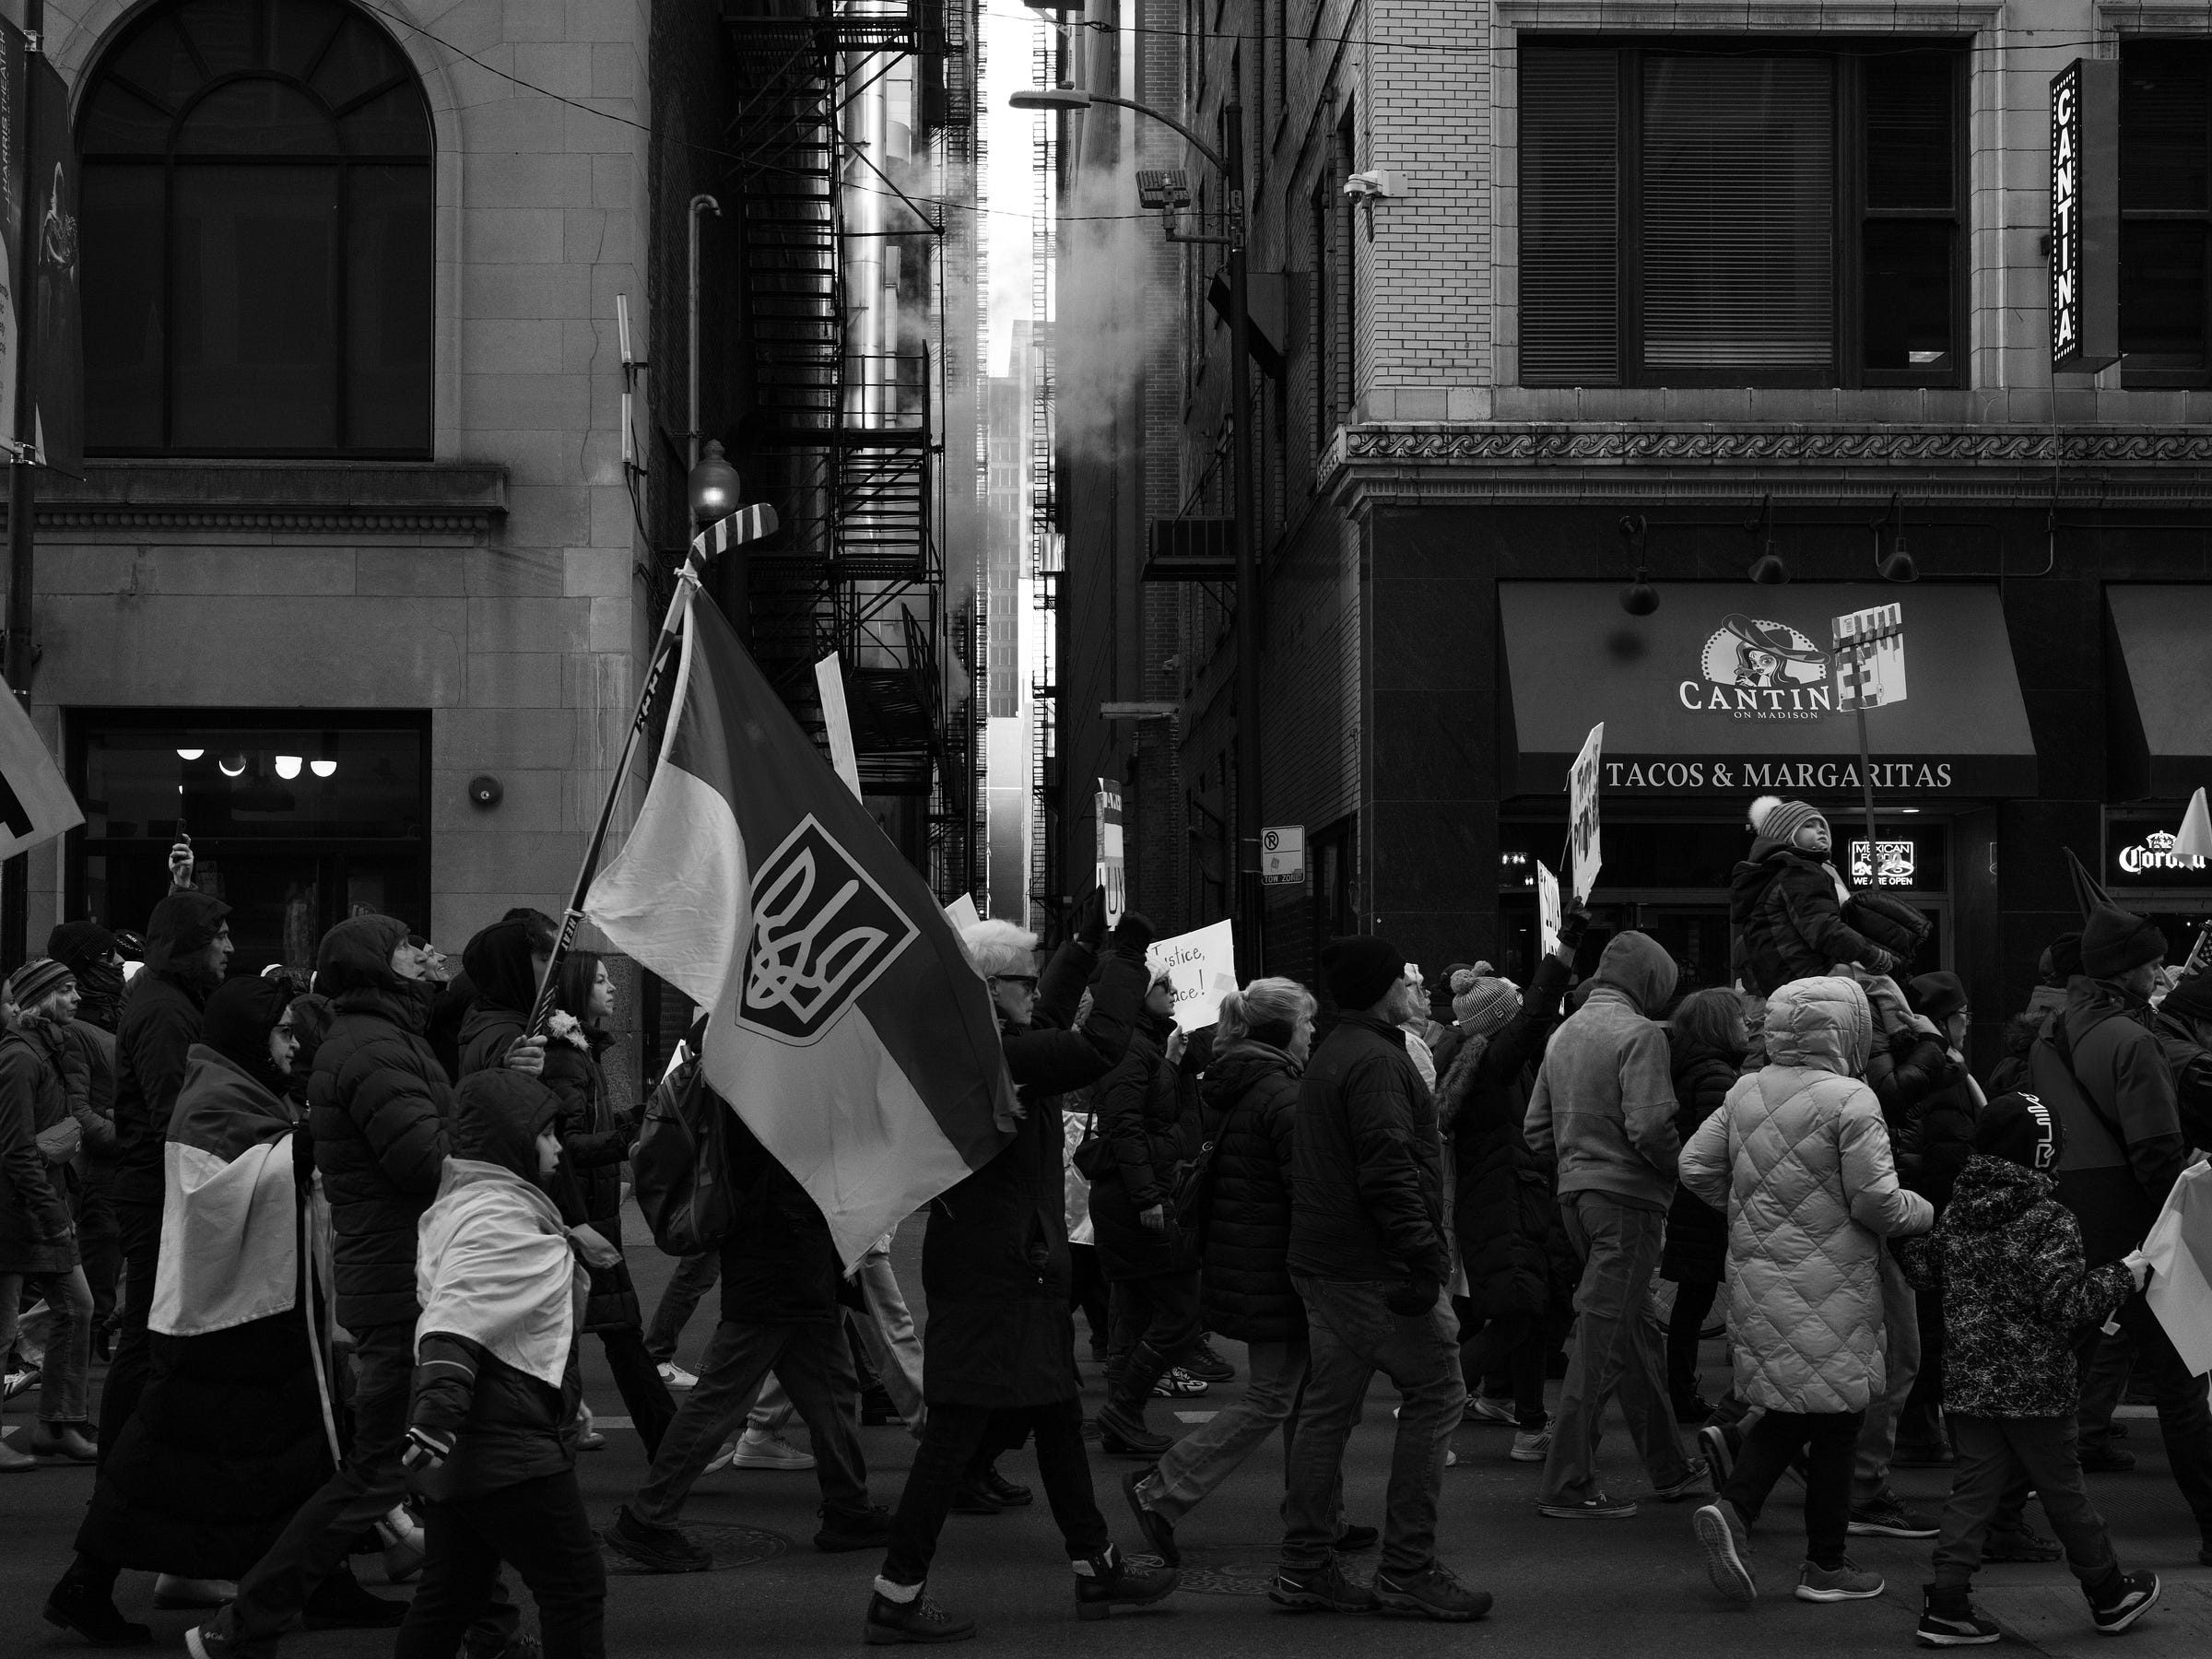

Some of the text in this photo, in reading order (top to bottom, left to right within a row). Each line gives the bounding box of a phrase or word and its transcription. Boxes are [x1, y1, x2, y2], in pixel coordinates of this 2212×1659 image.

[2057, 88, 2072, 347] CANTINA
[1679, 680, 1841, 711] CANTIN
[1734, 711, 1818, 719] ON MADISON
[1606, 762, 1704, 787] TACOS
[1712, 762, 1735, 787] &
[1742, 762, 1952, 787] MARGARITAS
[1855, 844, 1910, 853] MEXICAN
[2119, 844, 2206, 876] Coroa
[1853, 877, 1868, 886] WE
[1888, 877, 1913, 886] OPEN
